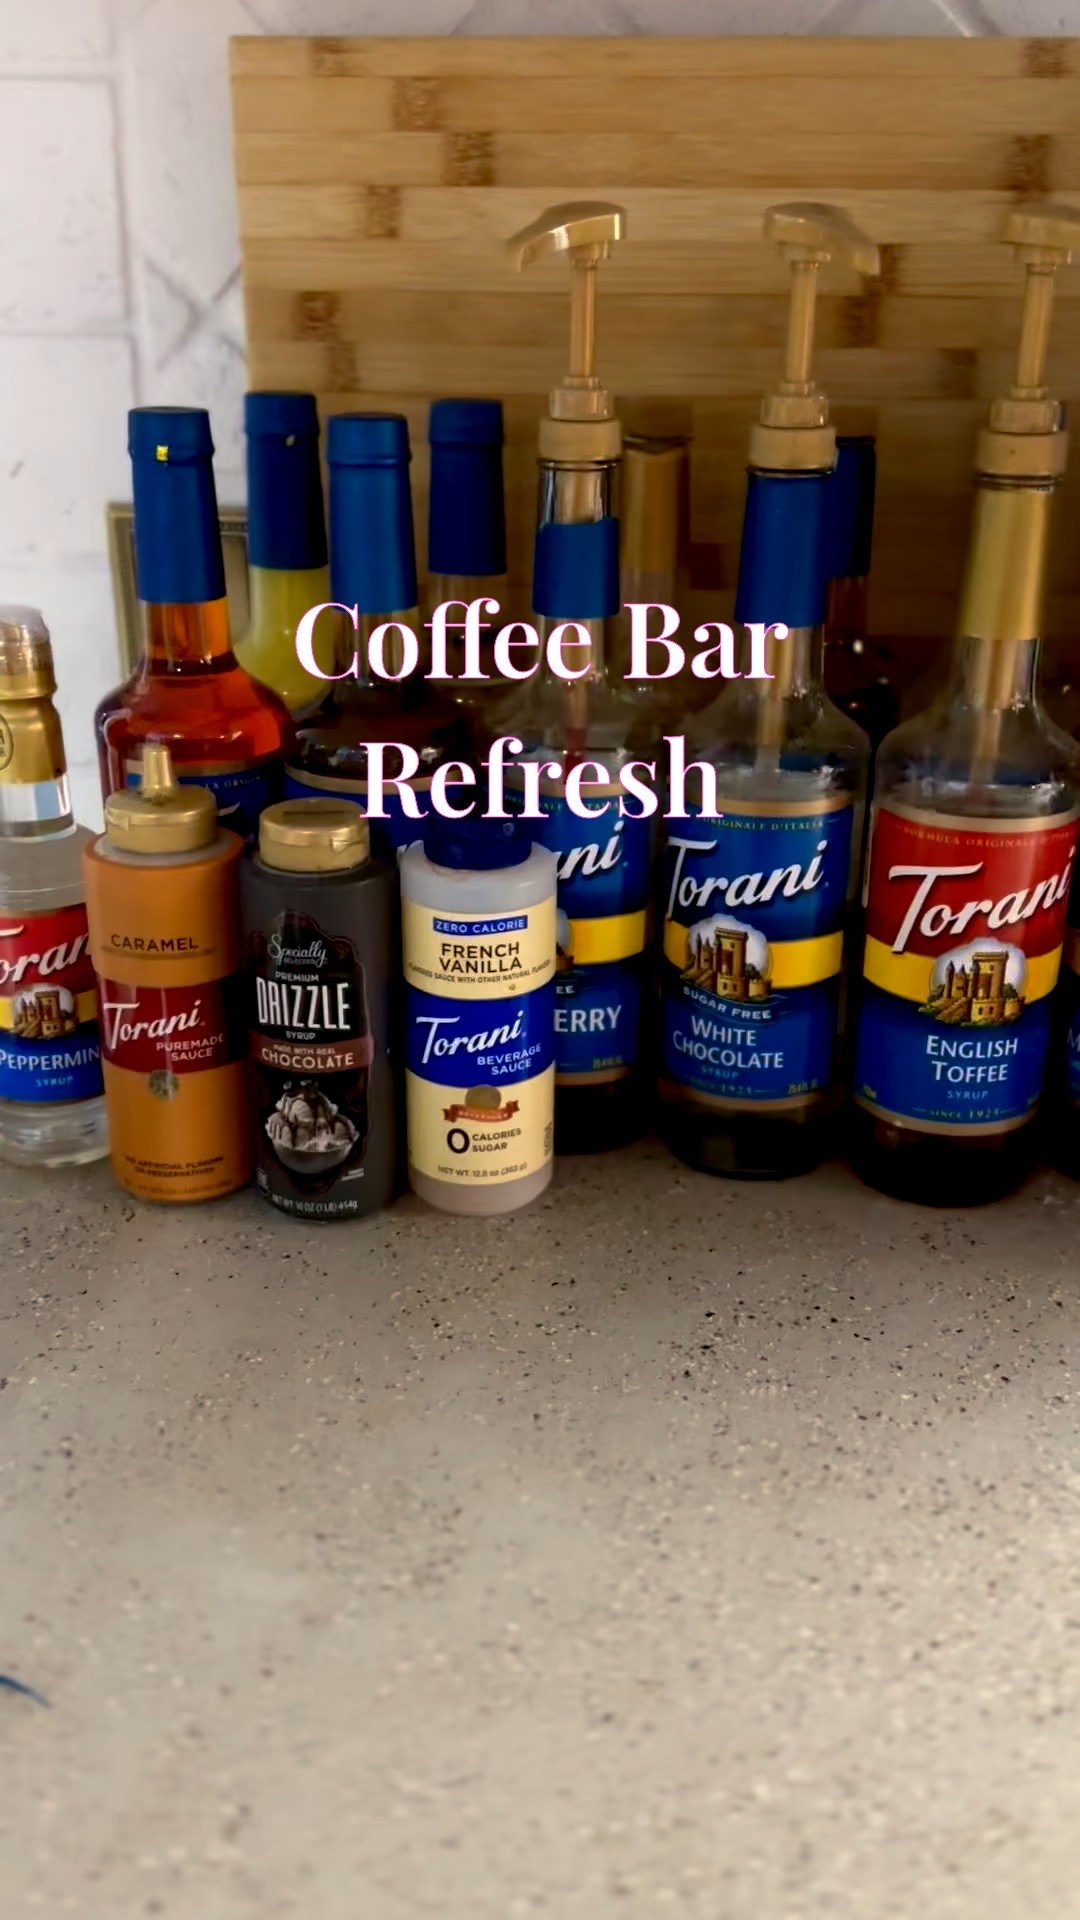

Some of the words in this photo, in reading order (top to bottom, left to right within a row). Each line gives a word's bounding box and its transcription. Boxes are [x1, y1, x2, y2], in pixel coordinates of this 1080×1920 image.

[904, 827, 960, 845] FORMULA
[667, 835, 828, 920] Torani
[888, 845, 1076, 954] Torani
[435, 920, 468, 933] ZERO
[472, 918, 525, 933] CALORIE
[111, 934, 199, 951] CARAMEL
[267, 933, 327, 968] Specially
[441, 941, 520, 959] FRENCH
[439, 957, 522, 973] VANILLA
[275, 970, 320, 982] PREMIUM
[435, 973, 455, 982] SAUCE
[457, 975, 476, 983] WITH
[477, 975, 501, 983] OTHER
[503, 969, 531, 981] NATURAL
[556, 985, 575, 994] EE
[256, 976, 351, 1030] DRIZZLE
[683, 986, 727, 1013] SUGAR
[731, 1007, 772, 1020] FREE
[103, 999, 202, 1049] Torani
[553, 1004, 622, 1032] ERRY
[285, 1030, 316, 1040] SYRUP
[416, 1010, 524, 1064] Torani
[691, 1015, 757, 1046] WHITE
[156, 1033, 224, 1051] PUREMADE
[672, 1030, 785, 1069] CHOCOLATE
[926, 1035, 1019, 1059] ENGLISH
[0, 1047, 100, 1072] PEPPERMIN
[171, 1047, 214, 1062] SAUCE
[261, 1047, 355, 1069] CHOCOLATE
[477, 1042, 542, 1065] BEVERAGE
[491, 1058, 533, 1075] SAUCE
[702, 1066, 739, 1079] SYRUP
[931, 1060, 1009, 1083] TOFFEE
[36, 1076, 74, 1087] SYRUP
[947, 1090, 988, 1100] SYRUP
[447, 1128, 470, 1154] 0
[472, 1128, 521, 1142] CALORIES
[472, 1142, 508, 1153] SUGAR
[438, 1165, 453, 1176] NET
[455, 1168, 469, 1177] WT
[472, 1169, 488, 1177] 12.8
